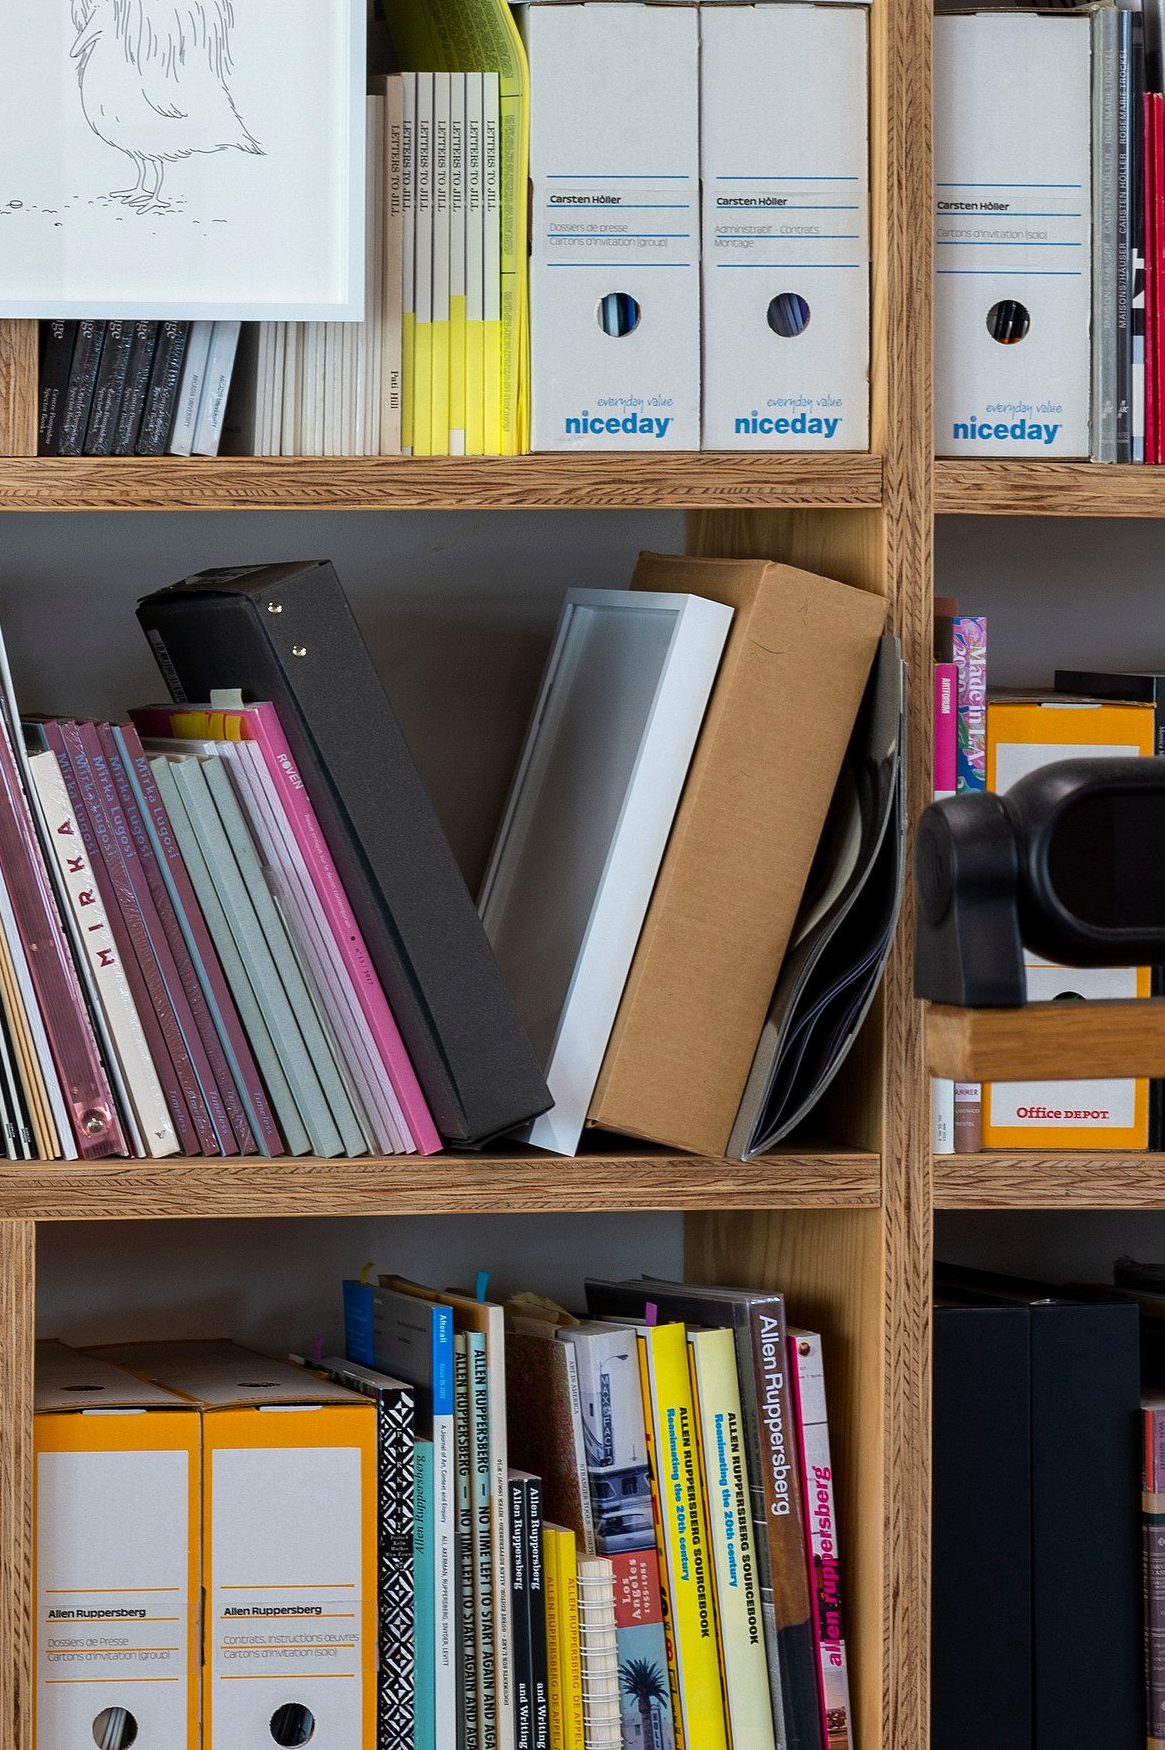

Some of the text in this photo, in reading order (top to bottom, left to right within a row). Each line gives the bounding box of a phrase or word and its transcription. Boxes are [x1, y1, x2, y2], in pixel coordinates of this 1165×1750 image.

[390, 124, 401, 219] LETTERS TO JILL
[549, 193, 589, 204] Carsten
[565, 410, 673, 439] niceday
[759, 1314, 790, 1517] Allen Ruppersberg
[811, 1464, 844, 1669] allen ruppersberg
[48, 1608, 146, 1619] Allen Ruppersberg
